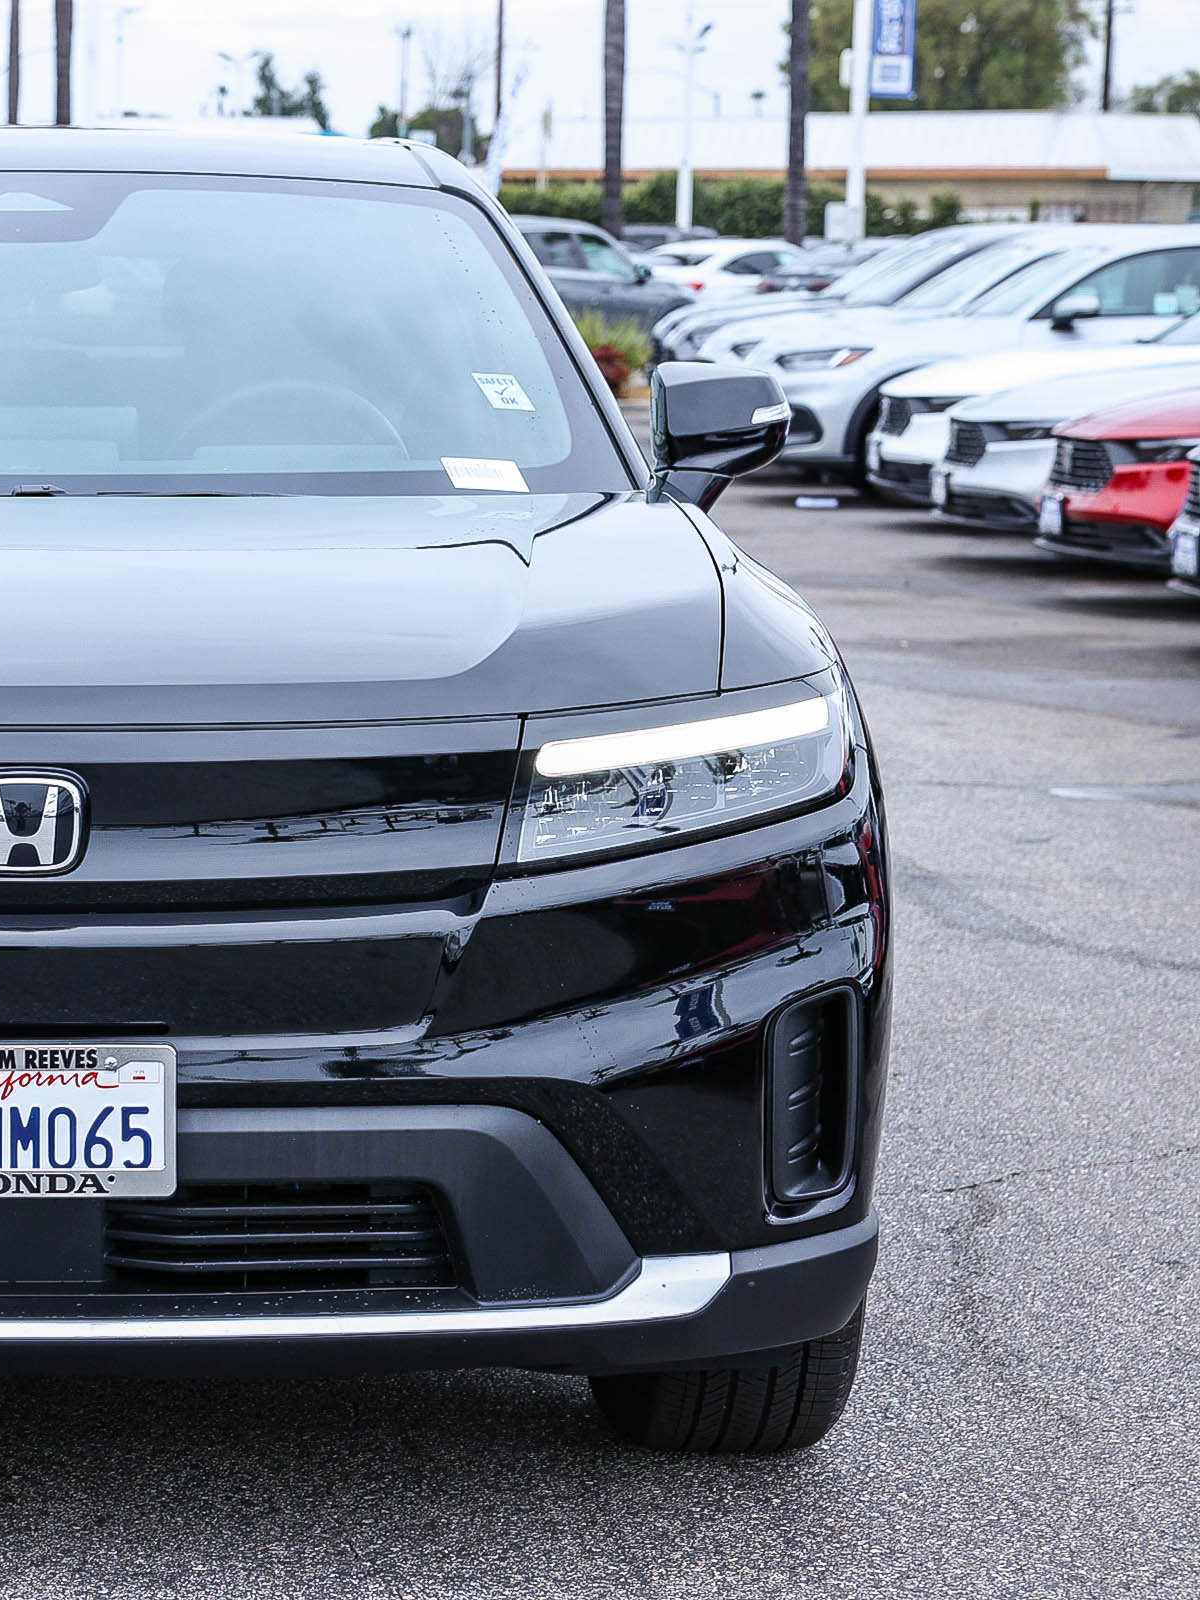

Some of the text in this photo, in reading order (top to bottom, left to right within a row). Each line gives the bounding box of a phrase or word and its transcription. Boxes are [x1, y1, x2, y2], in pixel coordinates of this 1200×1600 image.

[477, 377, 515, 386] SAFETY
[500, 397, 519, 405] OK
[24, 1049, 98, 1069] REEVES
